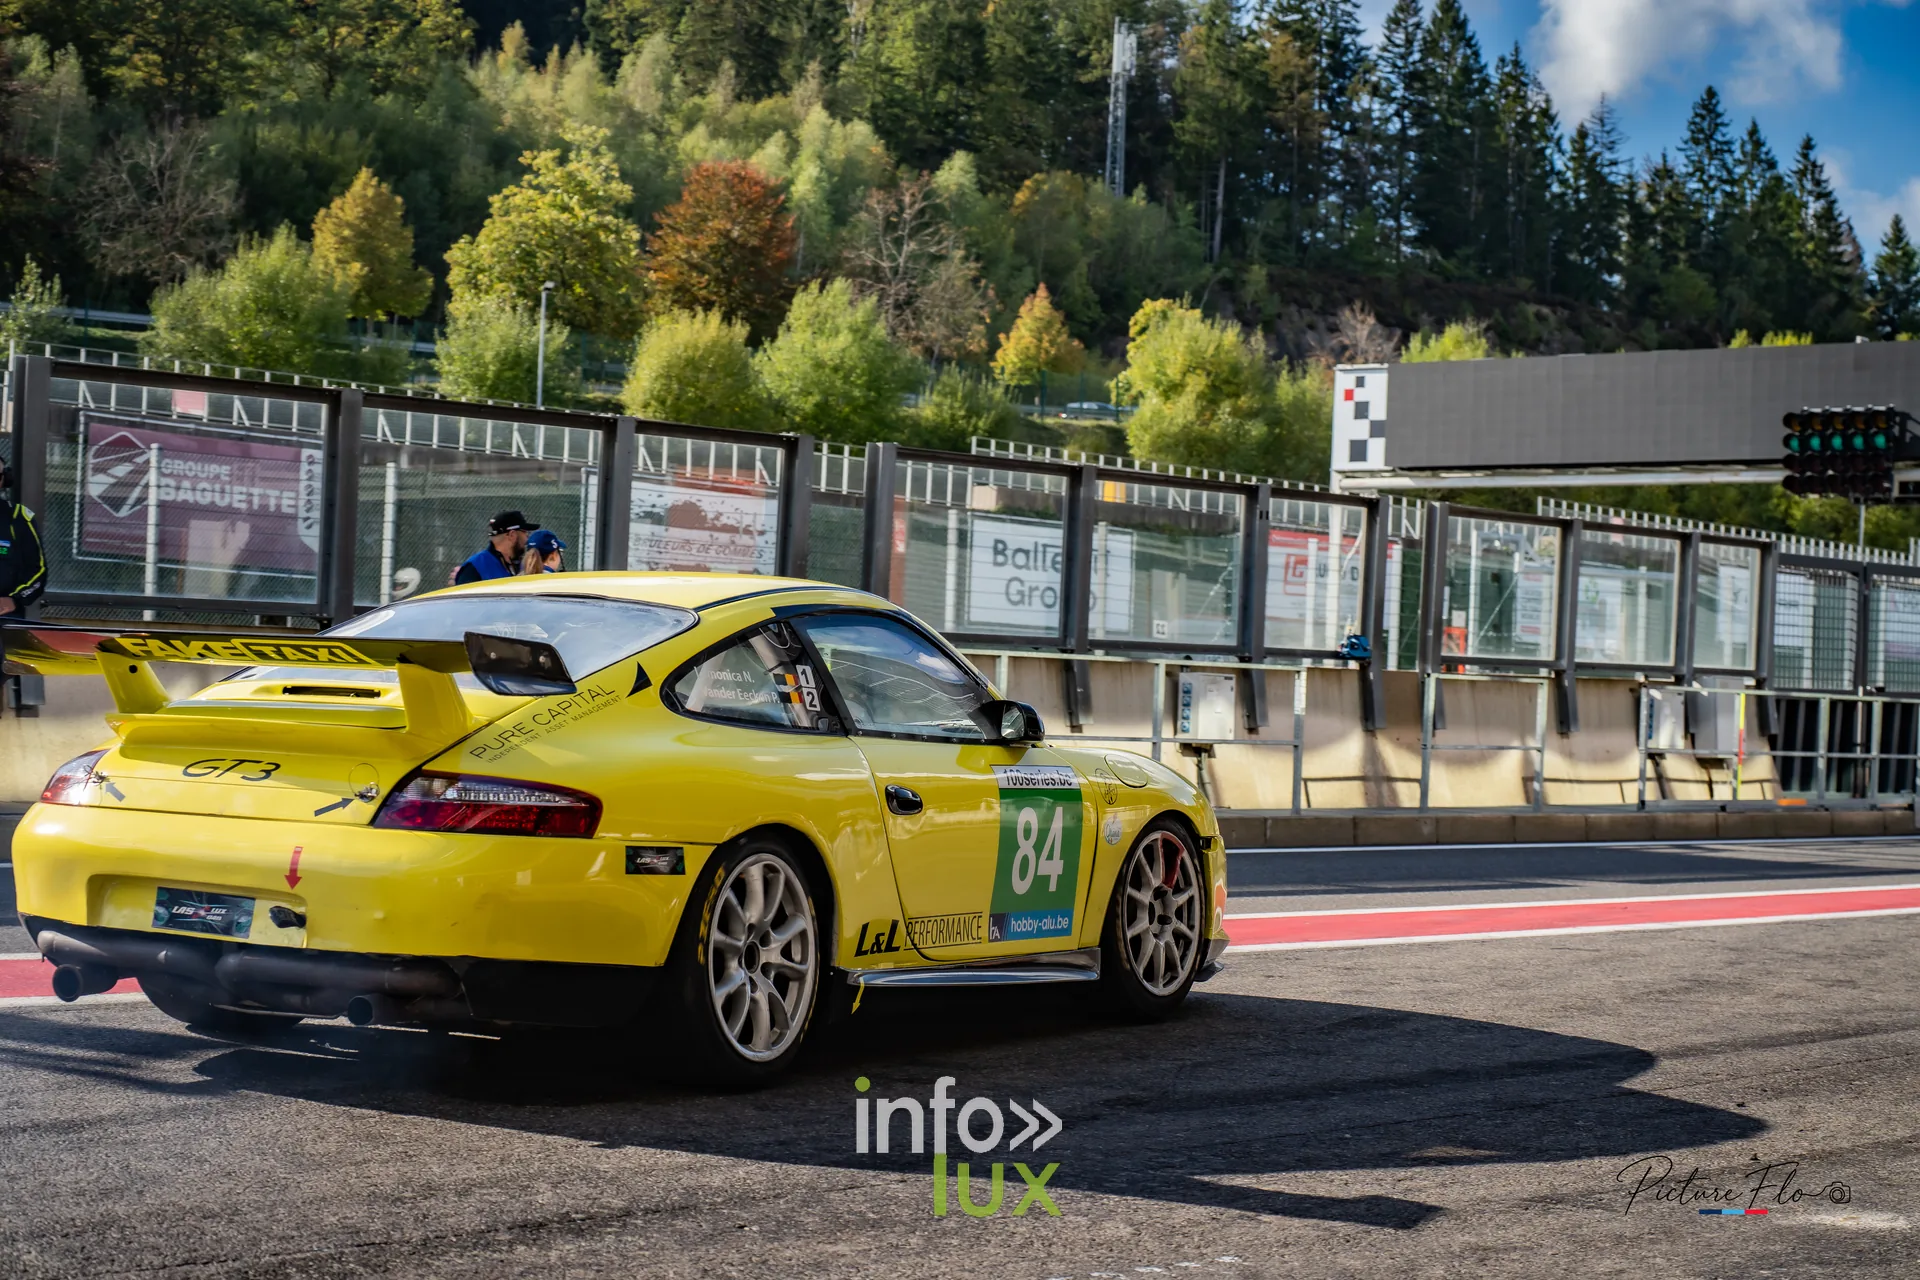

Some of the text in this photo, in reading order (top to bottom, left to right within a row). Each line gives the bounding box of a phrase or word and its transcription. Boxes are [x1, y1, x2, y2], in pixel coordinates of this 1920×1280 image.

[161, 458, 231, 481] GROUPE
[158, 477, 297, 514] BAGUETTE
[696, 543, 712, 555] DE
[1005, 576, 1097, 612] Gro
[115, 637, 242, 660] FAKE
[247, 645, 358, 663] TAXI
[742, 670, 755, 683] N.
[800, 668, 810, 685] 1
[771, 691, 781, 704] P.
[806, 691, 817, 708] 2
[469, 684, 616, 760] PURE CAPITAL
[487, 695, 622, 764] INDEPENDENT ASSET MANAGEMENT
[182, 758, 281, 782] GT3
[1011, 806, 1064, 895] 84
[1010, 914, 1069, 934] hobby-alu.be
[854, 915, 982, 957] L&L PERFORMANCE
